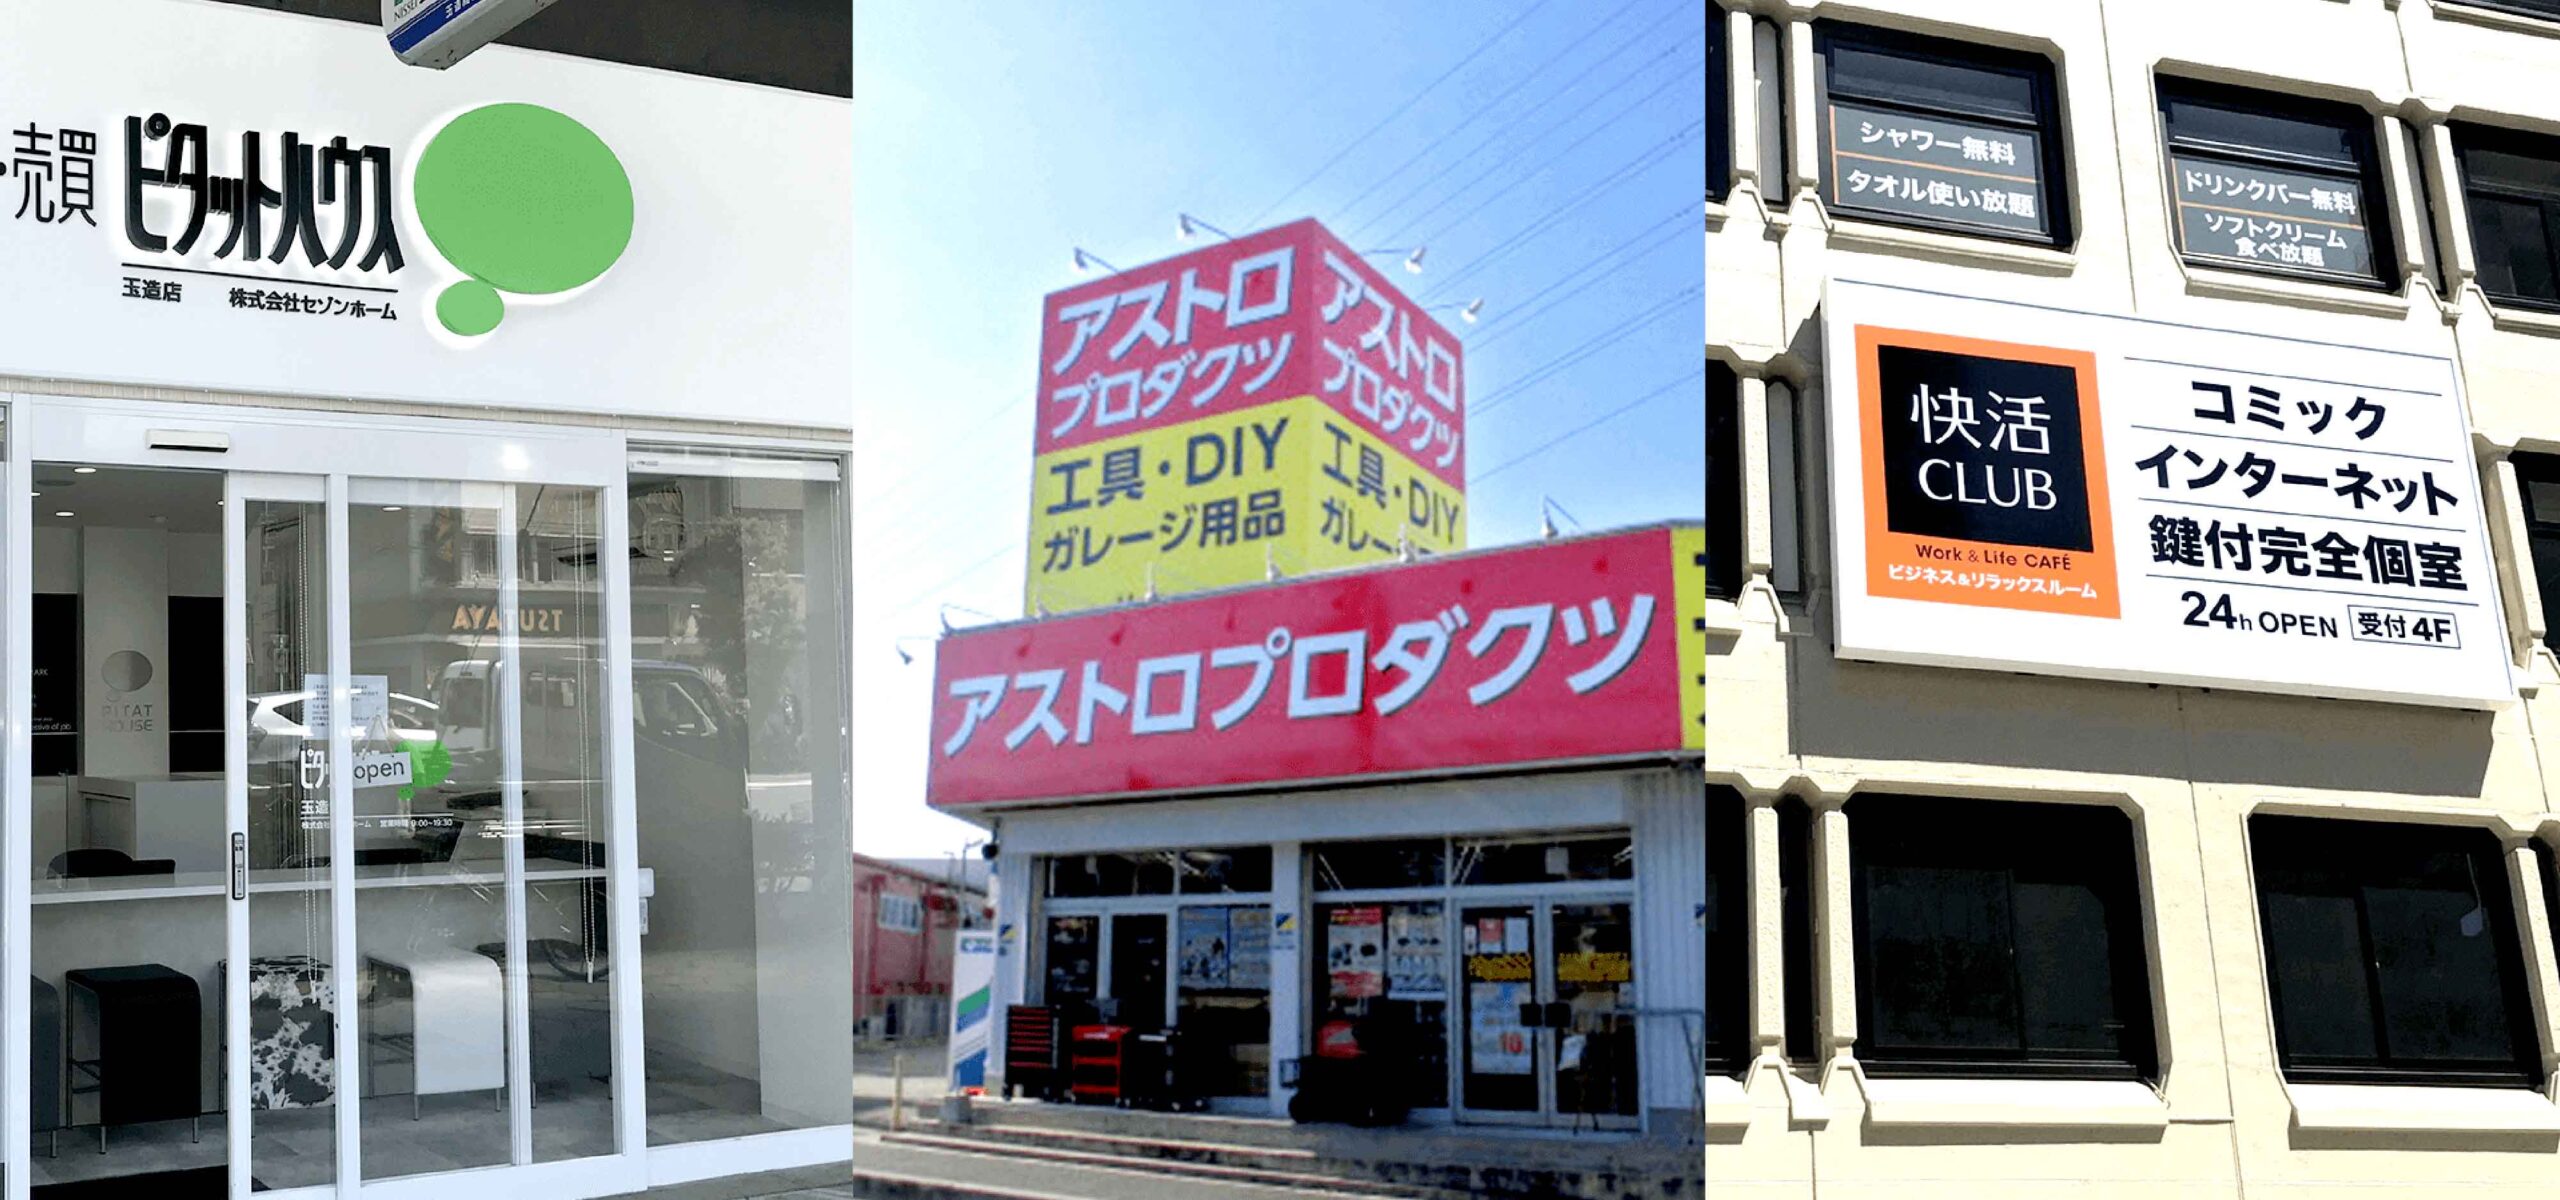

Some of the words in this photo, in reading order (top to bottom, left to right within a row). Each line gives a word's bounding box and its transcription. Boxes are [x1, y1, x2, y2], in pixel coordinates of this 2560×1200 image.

[1860, 121, 2017, 166] シャワー無料
[124, 112, 405, 274] ピタットハウス
[1847, 168, 2036, 218] タオル使い放題
[2185, 169, 2356, 215] ドリンクバー無料
[2204, 212, 2348, 250] ソフトクリーム
[2235, 236, 2325, 267] 食べ放題
[122, 276, 183, 302] 玉造店
[229, 287, 398, 321] 株式会社セゾンホーム
[1052, 245, 1297, 376] アストロ
[1322, 250, 1458, 412] アストロ
[1052, 332, 1295, 438] プロダクツ
[1322, 337, 1459, 470] プロダクツ
[2191, 379, 2387, 440] コミック
[1910, 382, 2052, 456] 快活
[1917, 458, 2058, 511] CLUB
[2135, 445, 2459, 520] インターネット
[1042, 488, 1286, 573] ガレージ用品
[1915, 543, 1963, 561] Work
[1968, 549, 1980, 563] &
[1984, 549, 2018, 567] Life
[2024, 553, 2072, 571] CAFÉ
[2148, 514, 2469, 592] 鍵付完全個室
[2181, 590, 2253, 631] 24h
[2258, 610, 2339, 638] OPEN
[943, 594, 1656, 758] アストロプロダクツ
[353, 760, 405, 784] open
[300, 800, 329, 815] 玉造
